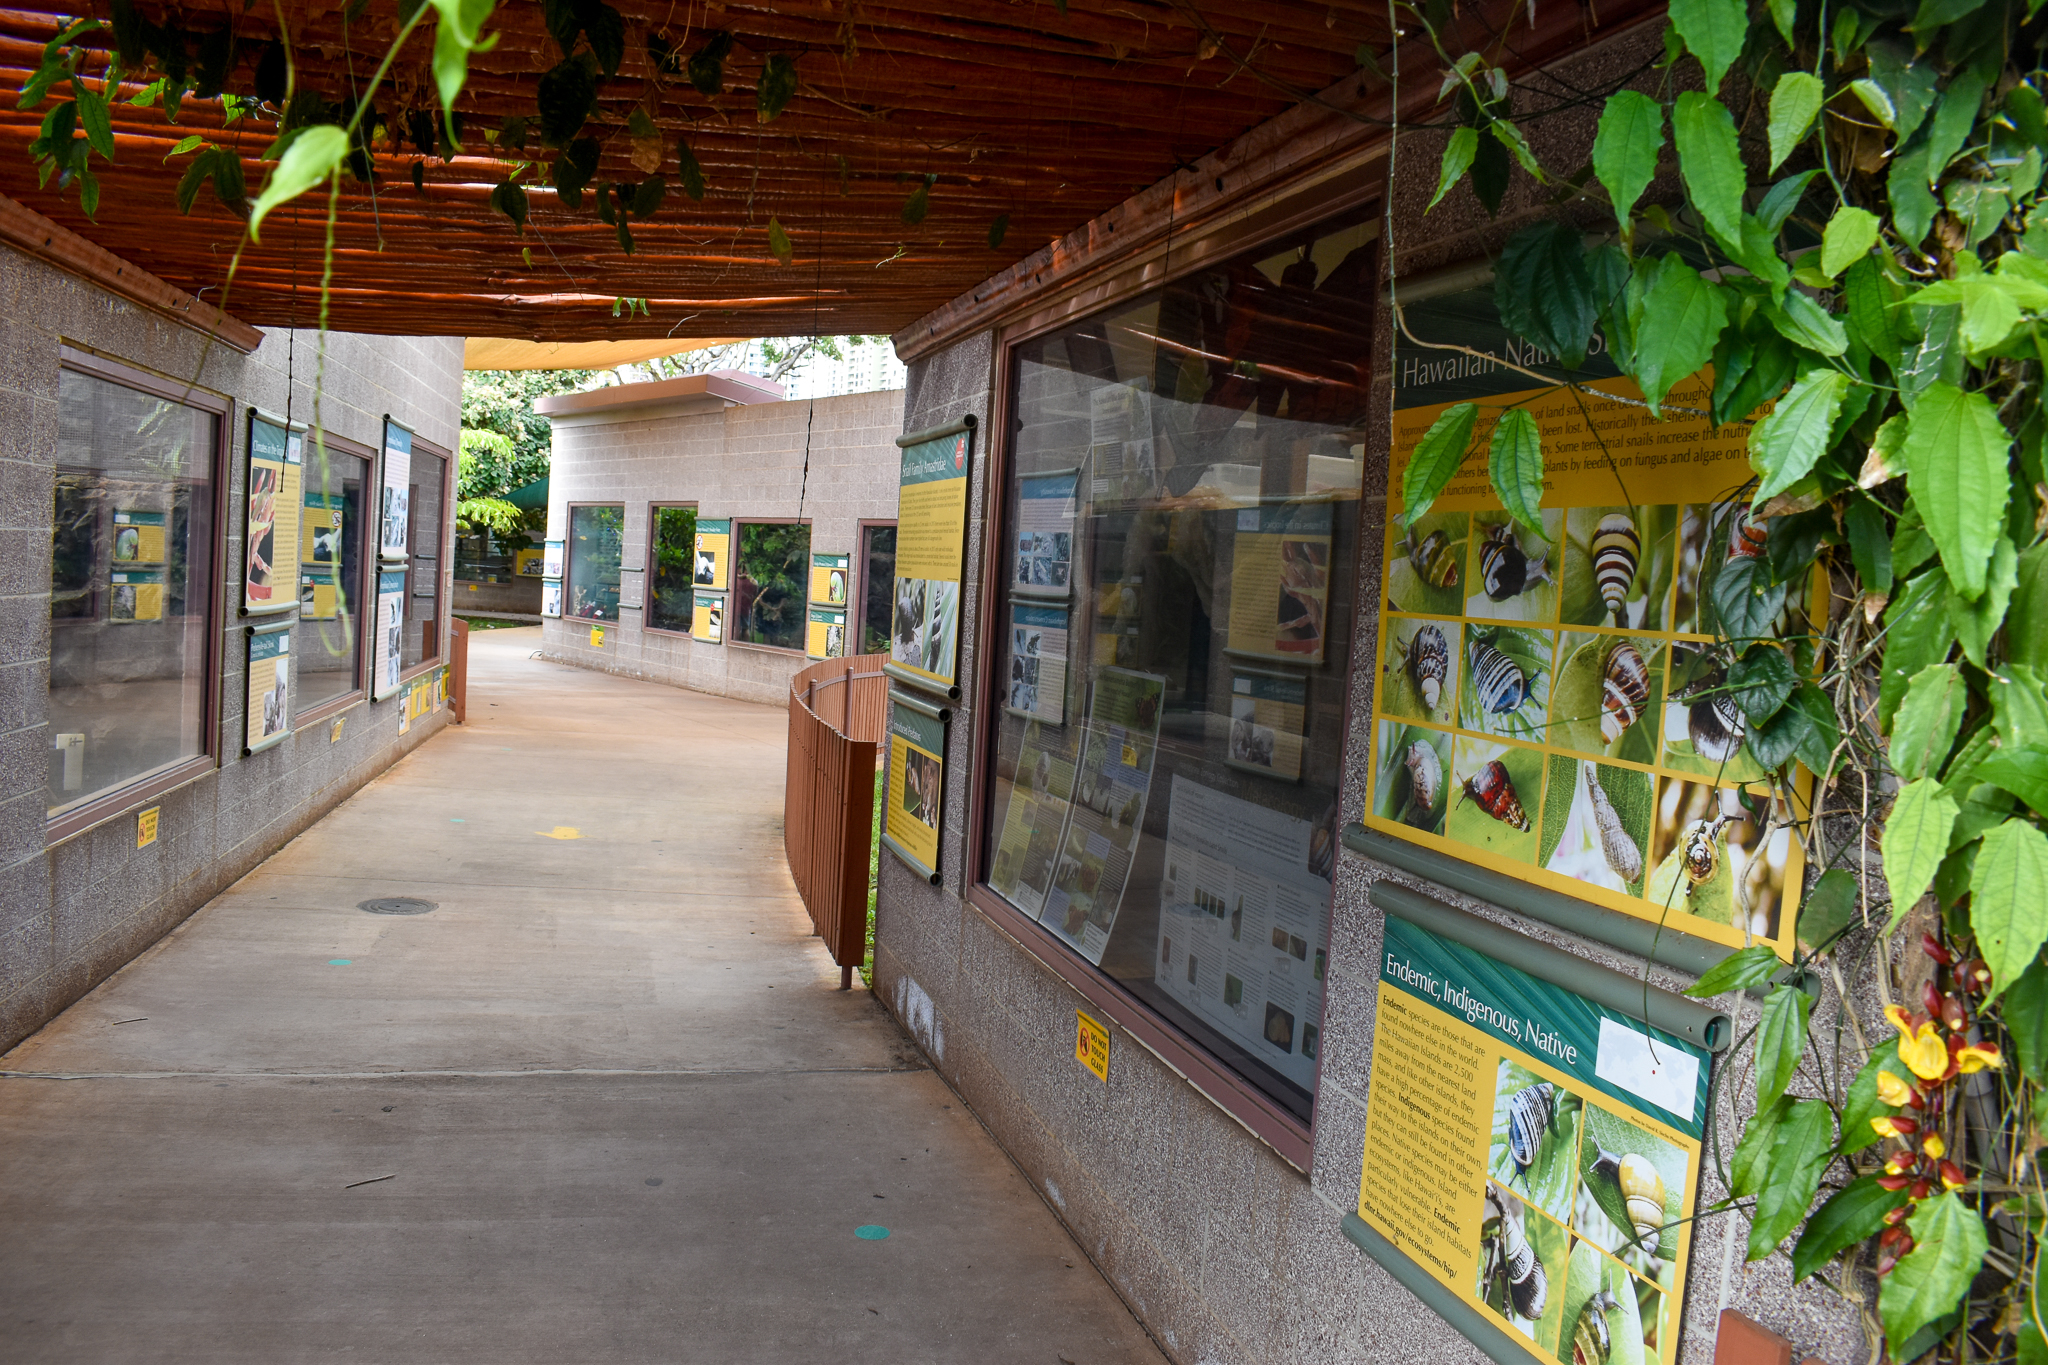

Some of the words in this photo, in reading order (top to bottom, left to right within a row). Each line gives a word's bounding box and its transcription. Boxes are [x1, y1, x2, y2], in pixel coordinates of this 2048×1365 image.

[1403, 350, 1496, 388] Hawaiian
[1398, 440, 1418, 452] Island
[1542, 425, 1563, 436] been
[1565, 420, 1584, 434] lost.
[1399, 424, 1431, 439] Approxim
[1535, 408, 1544, 420] of
[1546, 405, 1565, 418] land
[1593, 402, 1616, 412] once
[1540, 443, 1553, 458] try.
[1555, 441, 1579, 453] Some
[1581, 435, 1624, 451] terrestrial
[1626, 432, 1654, 447] snails
[1656, 431, 1700, 444] increase
[902, 462, 911, 478] Snail
[912, 460, 924, 478] Family
[1447, 483, 1487, 497] functioning
[1570, 458, 1581, 474] by
[1583, 456, 1618, 471] feeding
[1620, 457, 1632, 467] on
[1635, 453, 1669, 469] fungus
[1670, 448, 1692, 463] and
[1693, 448, 1723, 465] algae
[1725, 449, 1742, 460] on
[1382, 1008, 1398, 1025] found
[1399, 1021, 1424, 1040] nowhere
[1426, 1034, 1438, 1047] else
[1439, 1040, 1445, 1051] in
[1447, 1044, 1457, 1058] the
[1459, 1053, 1479, 1070] world.
[1383, 995, 1407, 1015] Endemic
[1409, 1011, 1429, 1027] species
[1431, 1023, 1441, 1033] are
[1442, 1026, 1459, 1043] those
[1461, 1036, 1473, 1050] that
[1474, 1046, 1485, 1057] are
[1386, 953, 1441, 1002] Endemic,
[1443, 979, 1522, 1043] Indigenous,
[1525, 1019, 1578, 1066] Native
[1091, 1032, 1098, 1042] DO
[1098, 1038, 1107, 1050] NOT
[1091, 1044, 1106, 1062] TOUCH
[1091, 1058, 1104, 1074] GLASS
[1379, 1039, 1394, 1052] miles
[1395, 1048, 1410, 1064] away
[1411, 1054, 1425, 1070] from
[1427, 1064, 1436, 1077] the
[1438, 1073, 1460, 1091] nearest
[1462, 1083, 1476, 1100] land
[1392, 1029, 1419, 1052] Hawaiian
[1421, 1045, 1441, 1064] Islands
[1443, 1060, 1453, 1071] are
[1454, 1064, 1473, 1082] 2,500
[1376, 1080, 1396, 1098] species.
[1399, 1092, 1430, 1120] Indigenous
[1432, 1116, 1454, 1135] species
[1456, 1128, 1475, 1148] found
[1377, 1063, 1390, 1079] have
[1396, 1075, 1408, 1092] high
[1409, 1087, 1442, 1113] percentage
[1444, 1107, 1450, 1116] of
[1452, 1112, 1479, 1135] endemic
[1378, 1053, 1393, 1068] mass,
[1394, 1063, 1406, 1074] and
[1407, 1066, 1417, 1081] like
[1419, 1077, 1434, 1091] other
[1436, 1084, 1458, 1107] islands,
[1461, 1100, 1475, 1118] they
[1372, 1120, 1390, 1139] places.
[1392, 1133, 1410, 1152] Native
[1412, 1148, 1433, 1168] species
[1435, 1164, 1448, 1180] may
[1449, 1170, 1457, 1184] be
[1459, 1180, 1477, 1197] either
[1373, 1104, 1382, 1118] but
[1383, 1112, 1395, 1129] they
[1396, 1123, 1407, 1135] can
[1408, 1131, 1419, 1142] still
[1420, 1135, 1428, 1149] be
[1429, 1142, 1447, 1162] found
[1449, 1155, 1454, 1167] in
[1456, 1163, 1473, 1178] other
[1374, 1092, 1387, 1106] their
[1388, 1103, 1399, 1117] way
[1401, 1110, 1406, 1119] to
[1408, 1113, 1417, 1126] the
[1419, 1120, 1439, 1141] islands
[1440, 1137, 1448, 1147] on
[1450, 1141, 1465, 1157] their
[1466, 1154, 1482, 1170] own,
[1368, 1162, 1397, 1190] particularly
[1400, 1185, 1431, 1213] vulnerable.
[1434, 1208, 1460, 1234] Endemic
[1369, 1148, 1401, 1177] ecosystems,
[1403, 1169, 1413, 1184] like
[1445, 1203, 1455, 1215] are
[1371, 1135, 1394, 1156] endemic
[1395, 1152, 1401, 1160] or
[1403, 1155, 1436, 1186] indigenous.
[1438, 1179, 1457, 1200] Island
[1364, 1200, 1457, 1278] dlnr.hawaii.gov/ecosystems/hip/
[1366, 1186, 1378, 1203] have
[1379, 1199, 1403, 1222] nowhere
[1405, 1218, 1416, 1232] else
[1417, 1227, 1423, 1238] to
[1424, 1234, 1434, 1246] go.
[1367, 1175, 1386, 1194] species
[1388, 1189, 1398, 1203] that
[1400, 1196, 1411, 1213] lose
[1412, 1207, 1426, 1224] their
[1427, 1218, 1445, 1239] island
[1447, 1232, 1471, 1258] habitats
